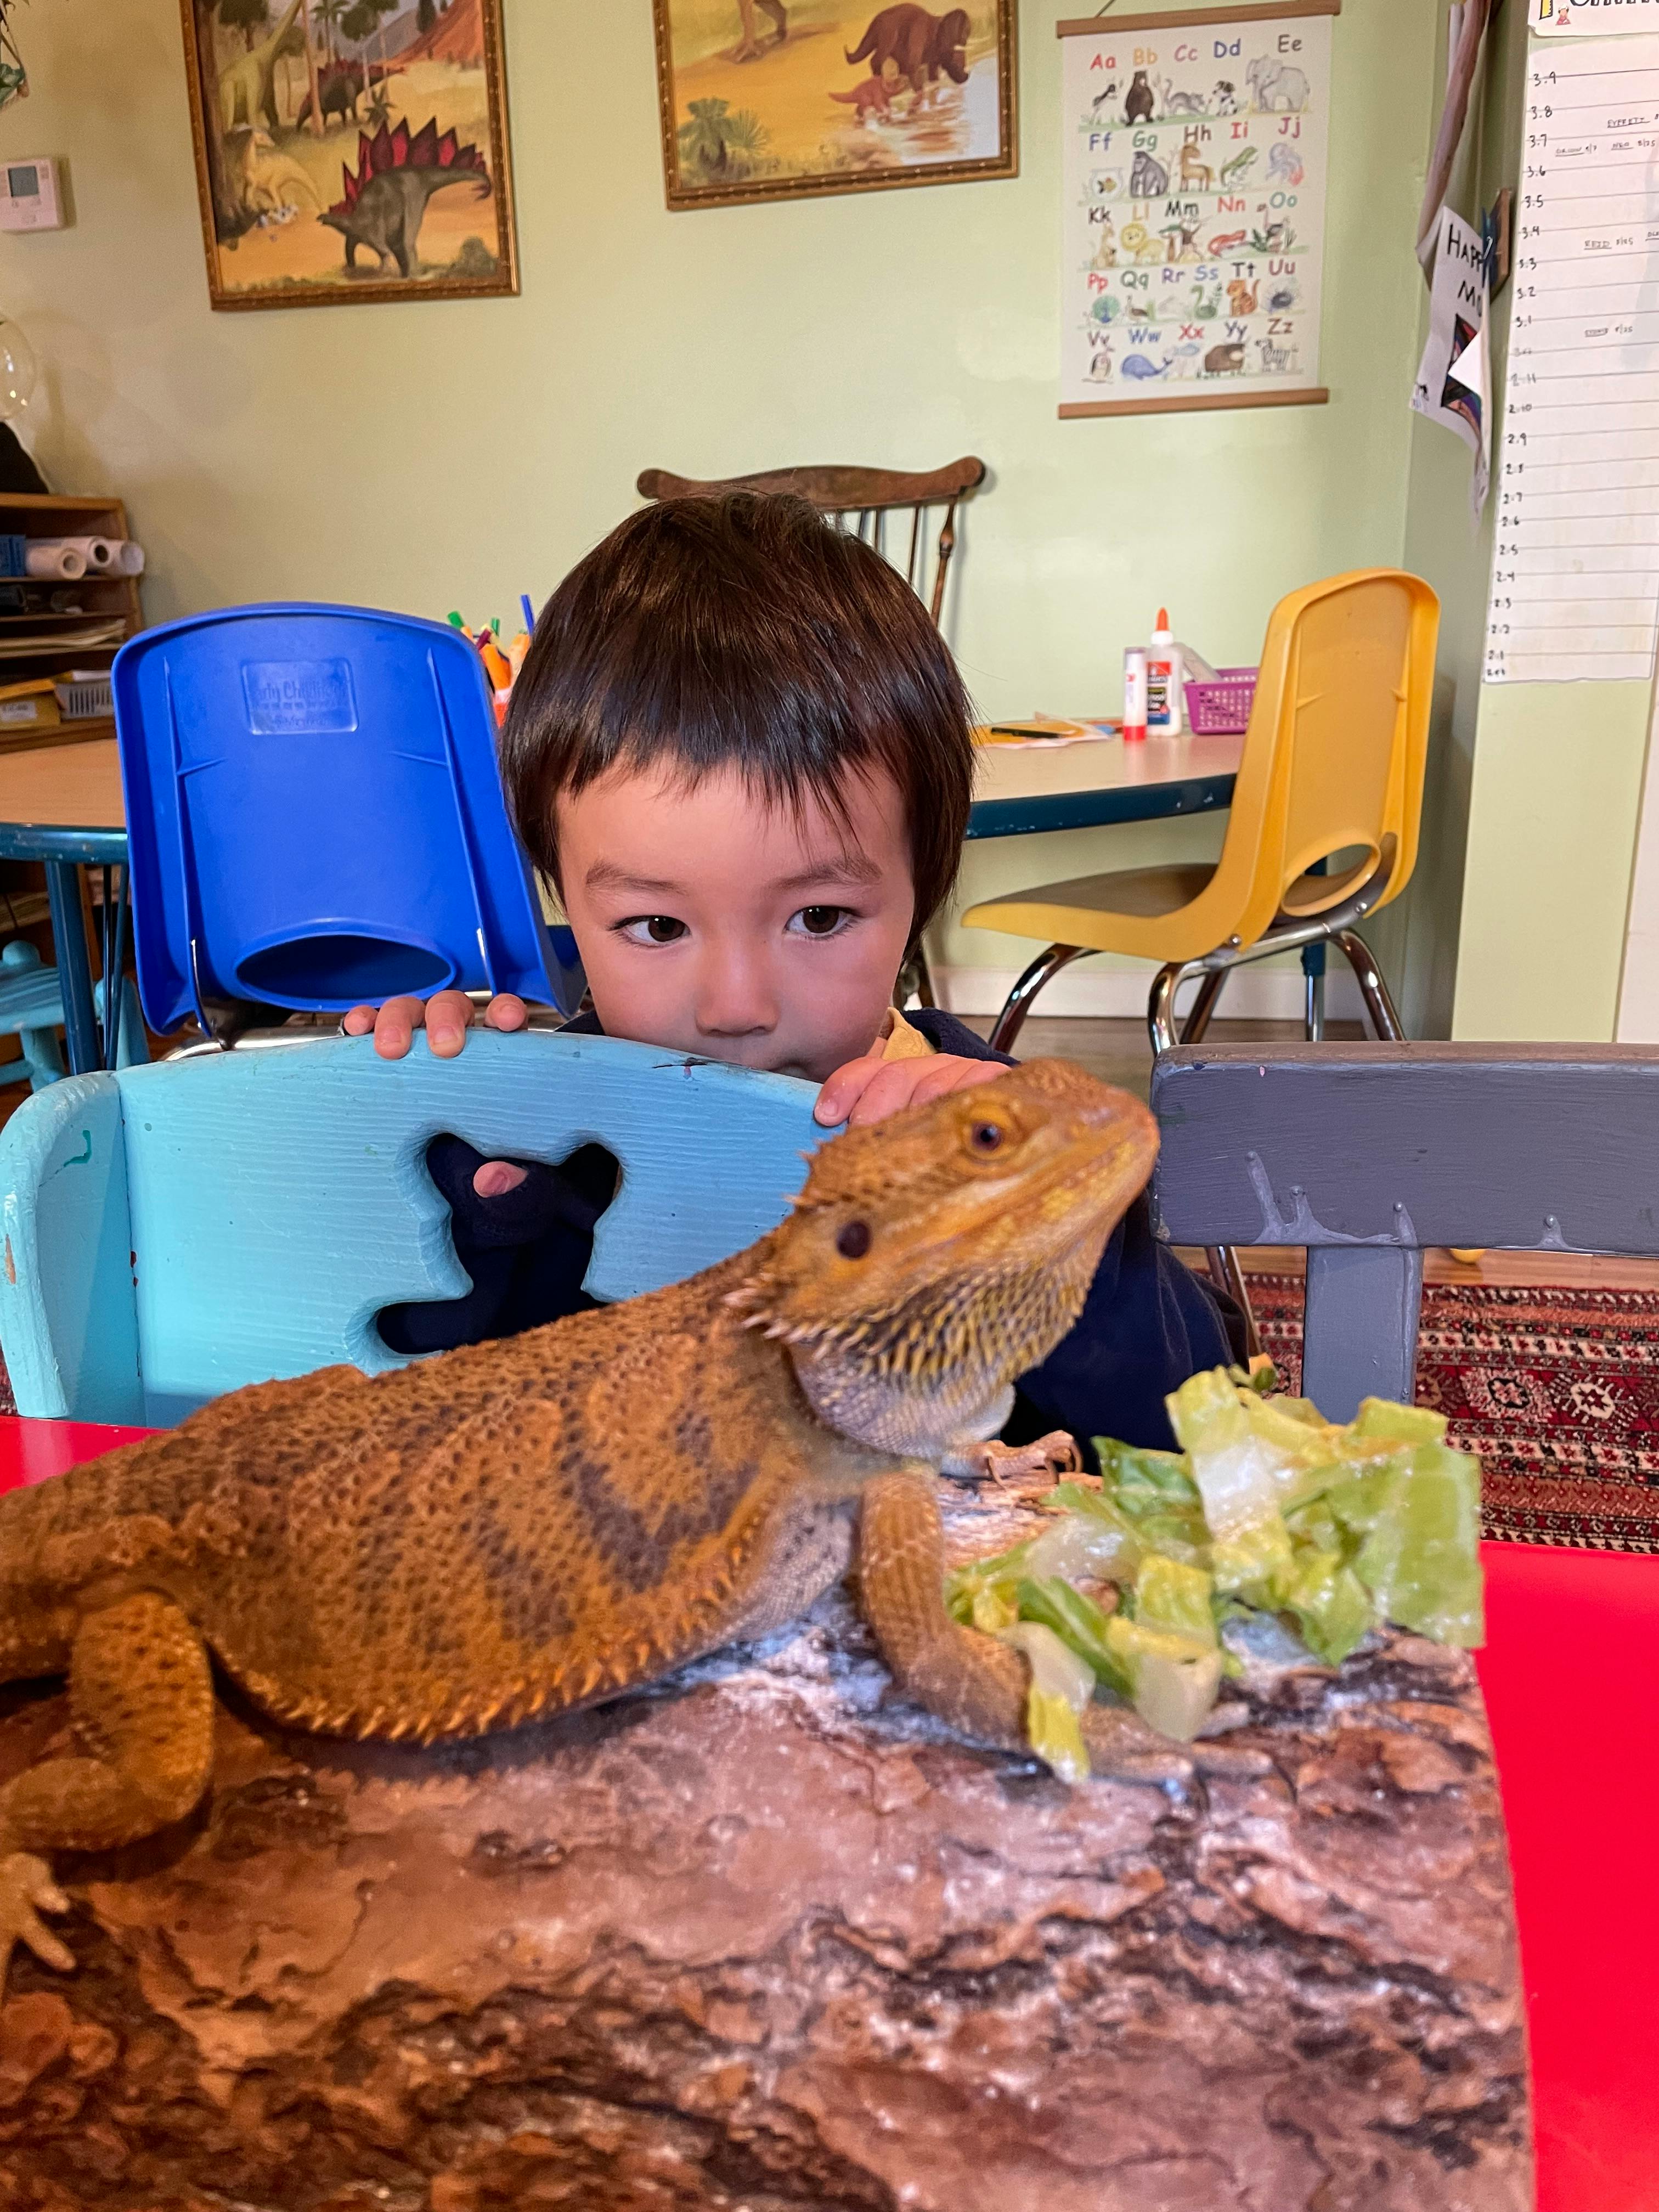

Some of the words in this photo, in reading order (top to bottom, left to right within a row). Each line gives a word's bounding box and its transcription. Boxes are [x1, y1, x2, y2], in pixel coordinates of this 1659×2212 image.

[1091, 54, 1116, 70] Aa
[1133, 49, 1158, 65] Bb
[1175, 45, 1198, 62] Cc
[1215, 38, 1241, 58] Dd
[1279, 35, 1302, 53] Ee
[1533, 71, 1556, 87] 3.9
[1531, 105, 1553, 120] 3.8
[1090, 133, 1111, 151] Ff
[1132, 131, 1158, 151] Gg
[1184, 126, 1211, 143] Hh
[1231, 122, 1248, 139] Ii
[1279, 117, 1301, 139] Jj
[1529, 134, 1547, 148] 3.7
[1527, 165, 1546, 178] 3.6
[1525, 194, 1544, 208] 3.5
[1088, 206, 1111, 224] Kk
[1133, 205, 1149, 221] Ll
[1165, 201, 1199, 217] Mm
[1218, 196, 1245, 212] Nn
[1270, 193, 1297, 208] Oo
[1522, 225, 1540, 239] 3.4
[1447, 223, 1483, 273] HAPP
[1519, 257, 1537, 270] 3.3
[1088, 273, 1108, 292] Pp
[1121, 270, 1149, 290] Qq
[1163, 268, 1184, 284] Rr
[1194, 266, 1218, 280] Ss
[1232, 263, 1255, 277] Tt
[1269, 260, 1295, 275] Uu
[1517, 286, 1536, 299] 3.2
[1516, 315, 1532, 328] 3.1
[1088, 332, 1110, 347] Vv
[1128, 328, 1160, 343] Ww
[1180, 324, 1203, 340] Xx
[1225, 321, 1247, 339] Yy
[1268, 318, 1293, 335] Zz
[1508, 432, 1527, 446] 2.9
[1503, 492, 1523, 504] 2.7
